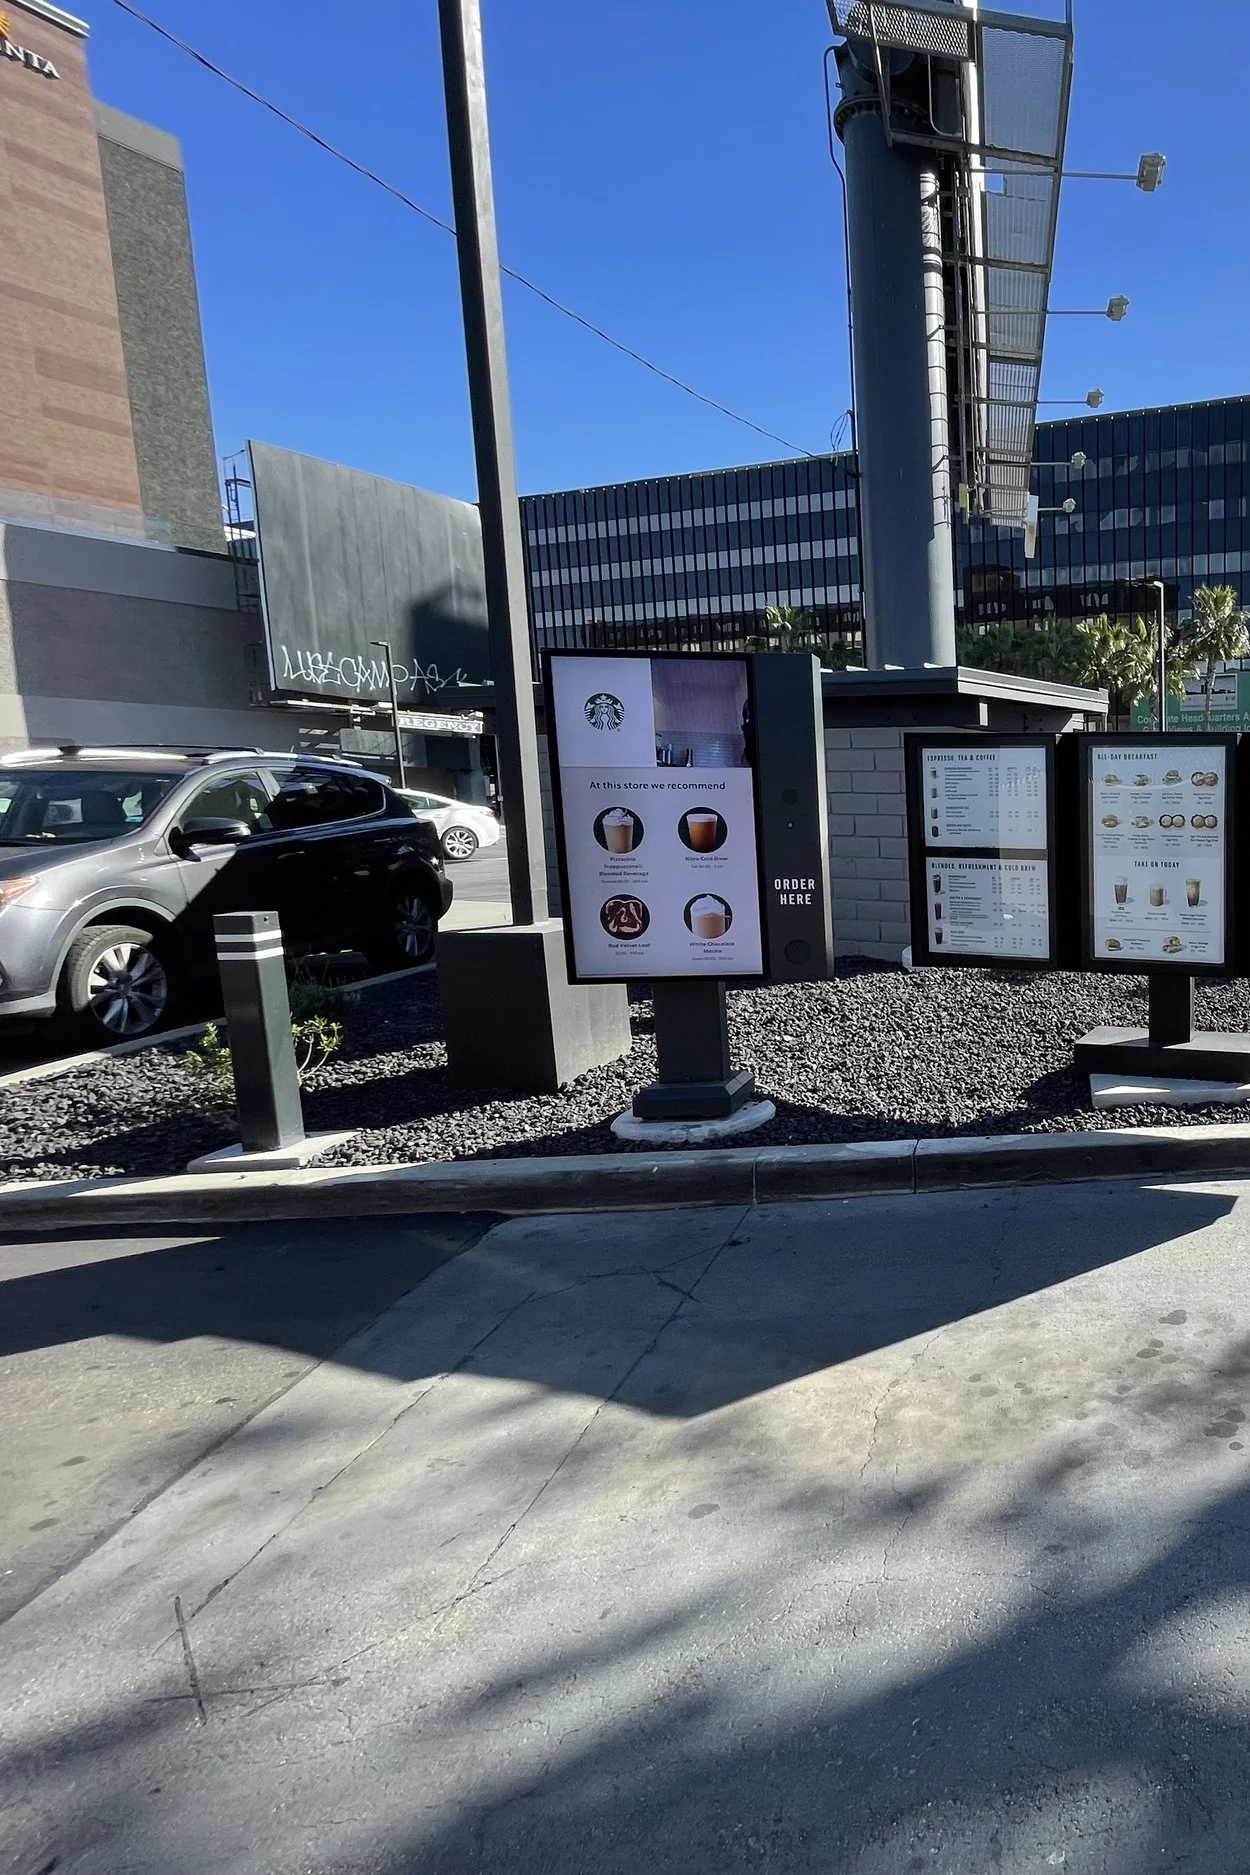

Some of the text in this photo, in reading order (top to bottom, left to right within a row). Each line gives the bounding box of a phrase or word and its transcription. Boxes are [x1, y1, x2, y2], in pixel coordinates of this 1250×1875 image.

[0, 39, 60, 79] NTA
[1181, 712, 1240, 723] Headuarters
[400, 718, 481, 732] REGENCY
[589, 781, 601, 790] At
[602, 781, 622, 790] this
[623, 782, 649, 790] store
[667, 781, 726, 790] recommend
[774, 878, 816, 890] ORDER
[780, 893, 812, 905] HERE
